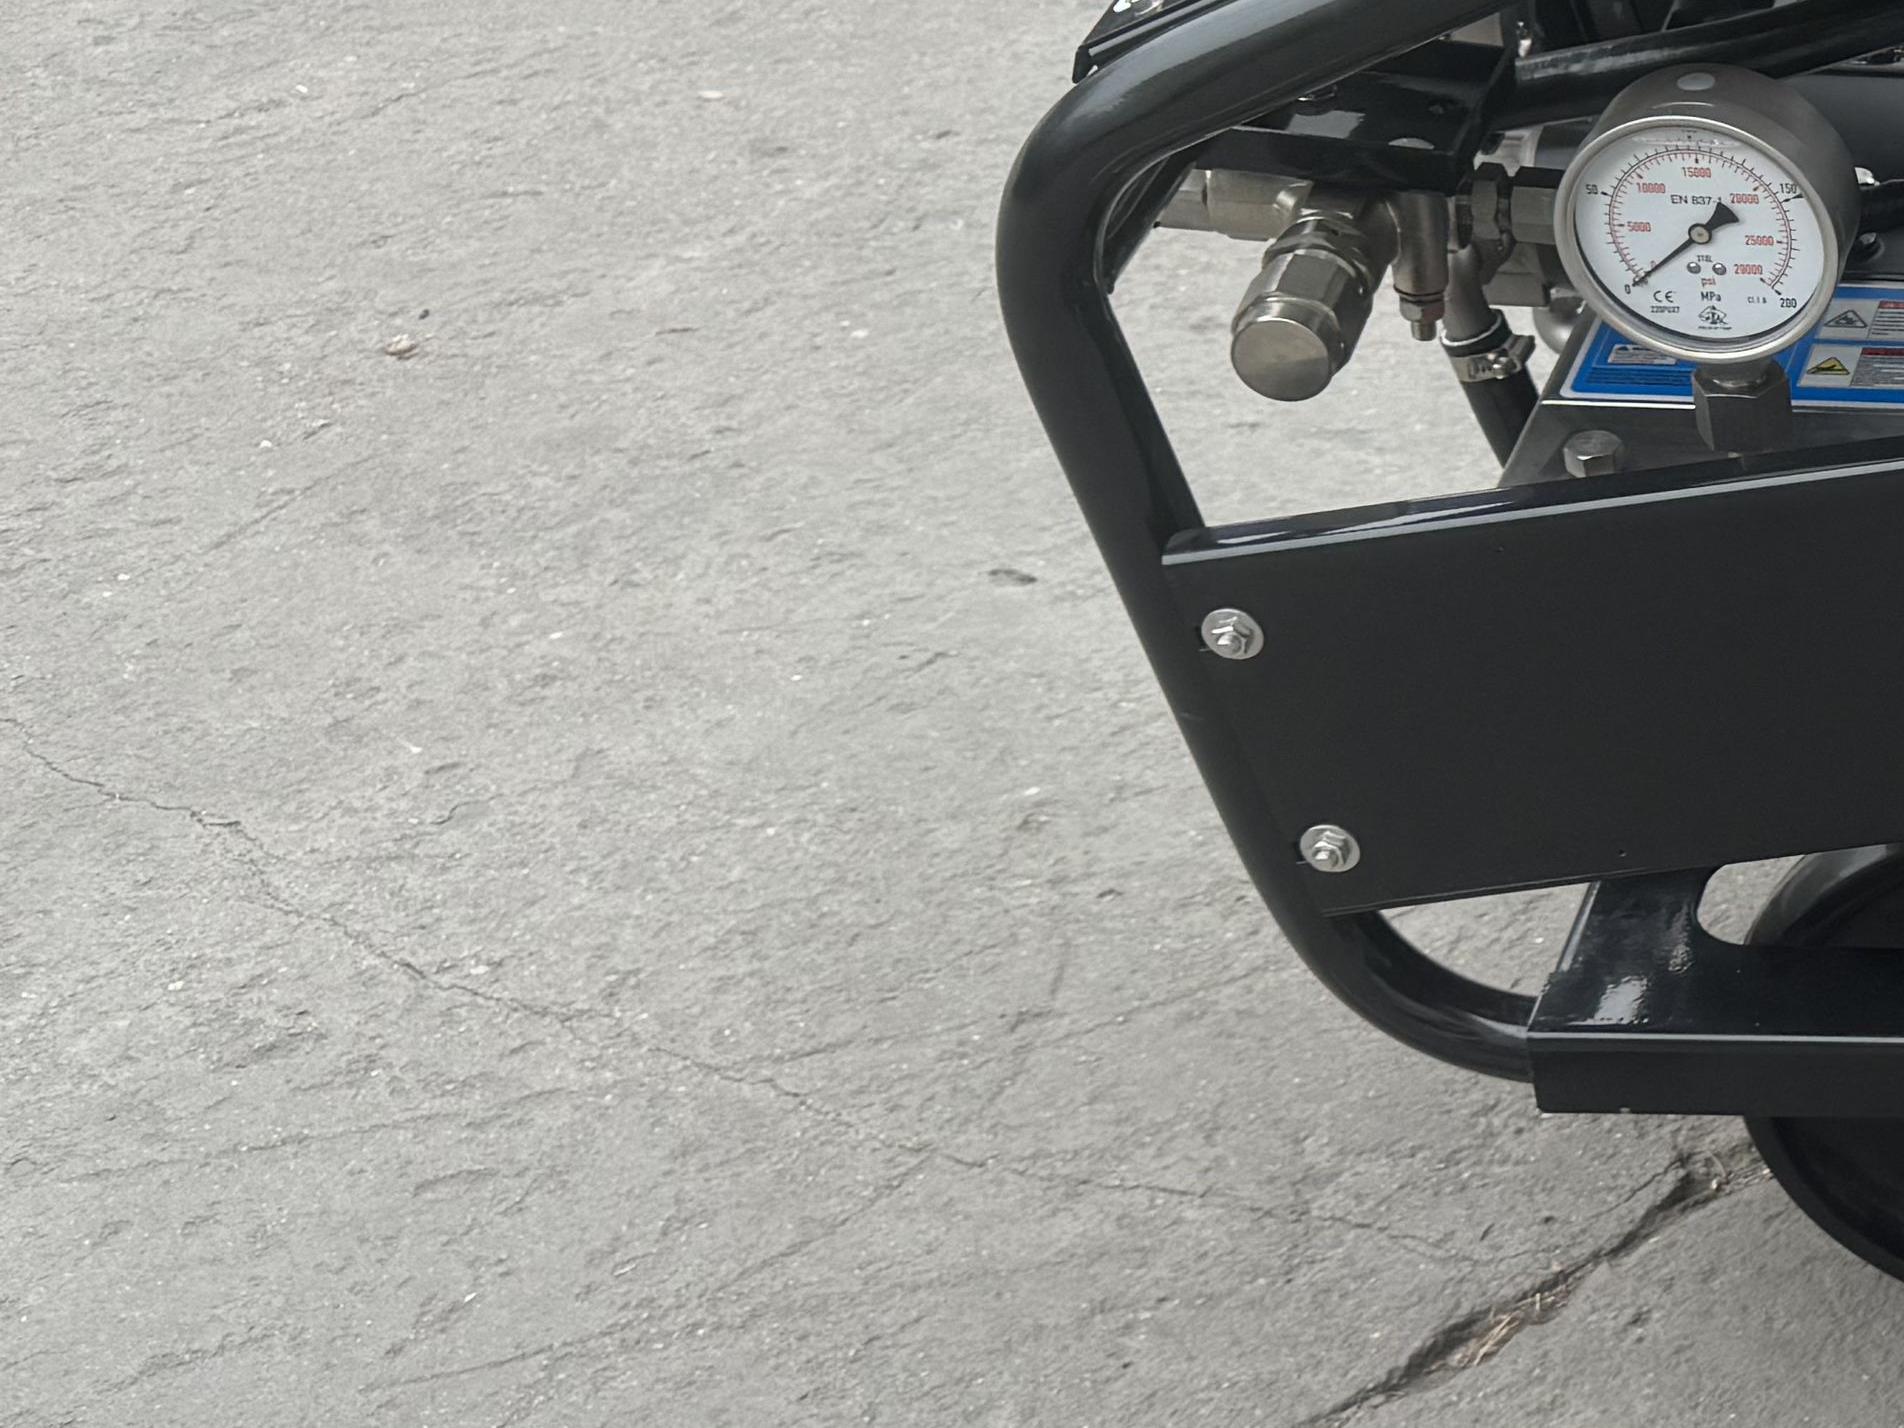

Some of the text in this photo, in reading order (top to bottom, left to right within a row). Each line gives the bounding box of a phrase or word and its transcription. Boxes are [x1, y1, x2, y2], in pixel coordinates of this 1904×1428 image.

[1585, 184, 1598, 195] 50
[1780, 183, 1798, 194] 150
[1670, 194, 1688, 205] EN
[1701, 291, 1722, 302] MPa
[1780, 298, 1797, 308] 200
